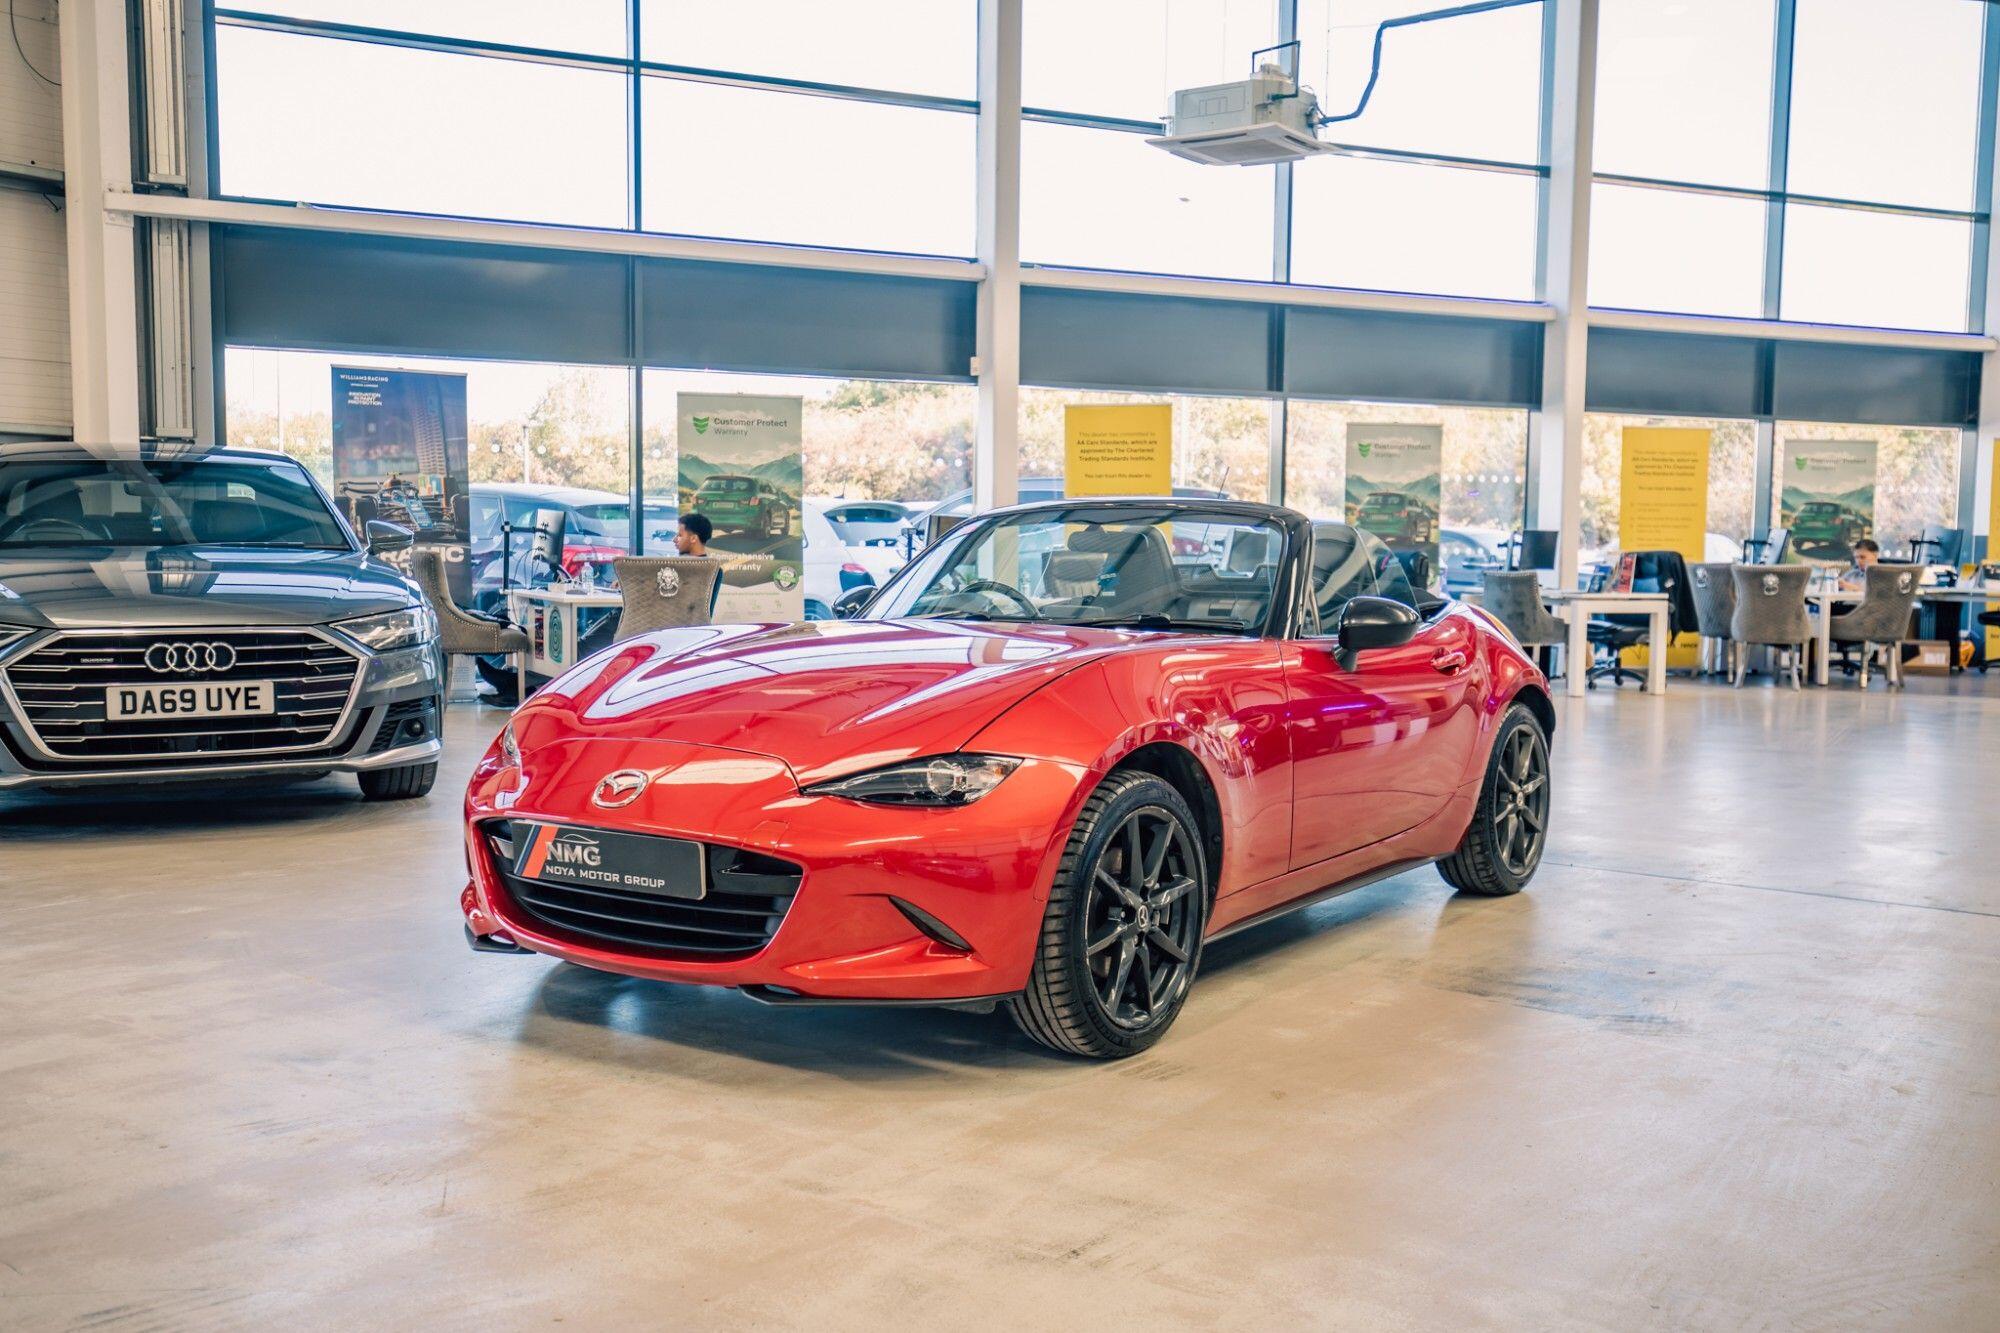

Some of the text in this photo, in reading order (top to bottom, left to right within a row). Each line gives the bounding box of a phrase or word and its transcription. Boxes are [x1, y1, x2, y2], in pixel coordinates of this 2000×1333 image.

[714, 418, 788, 428] Customer Protect
[714, 428, 748, 436] Warranty
[119, 686, 261, 716] DA69 UYE
[546, 842, 601, 866] NMG
[545, 865, 666, 889] NOYA MOTOR GROUP
